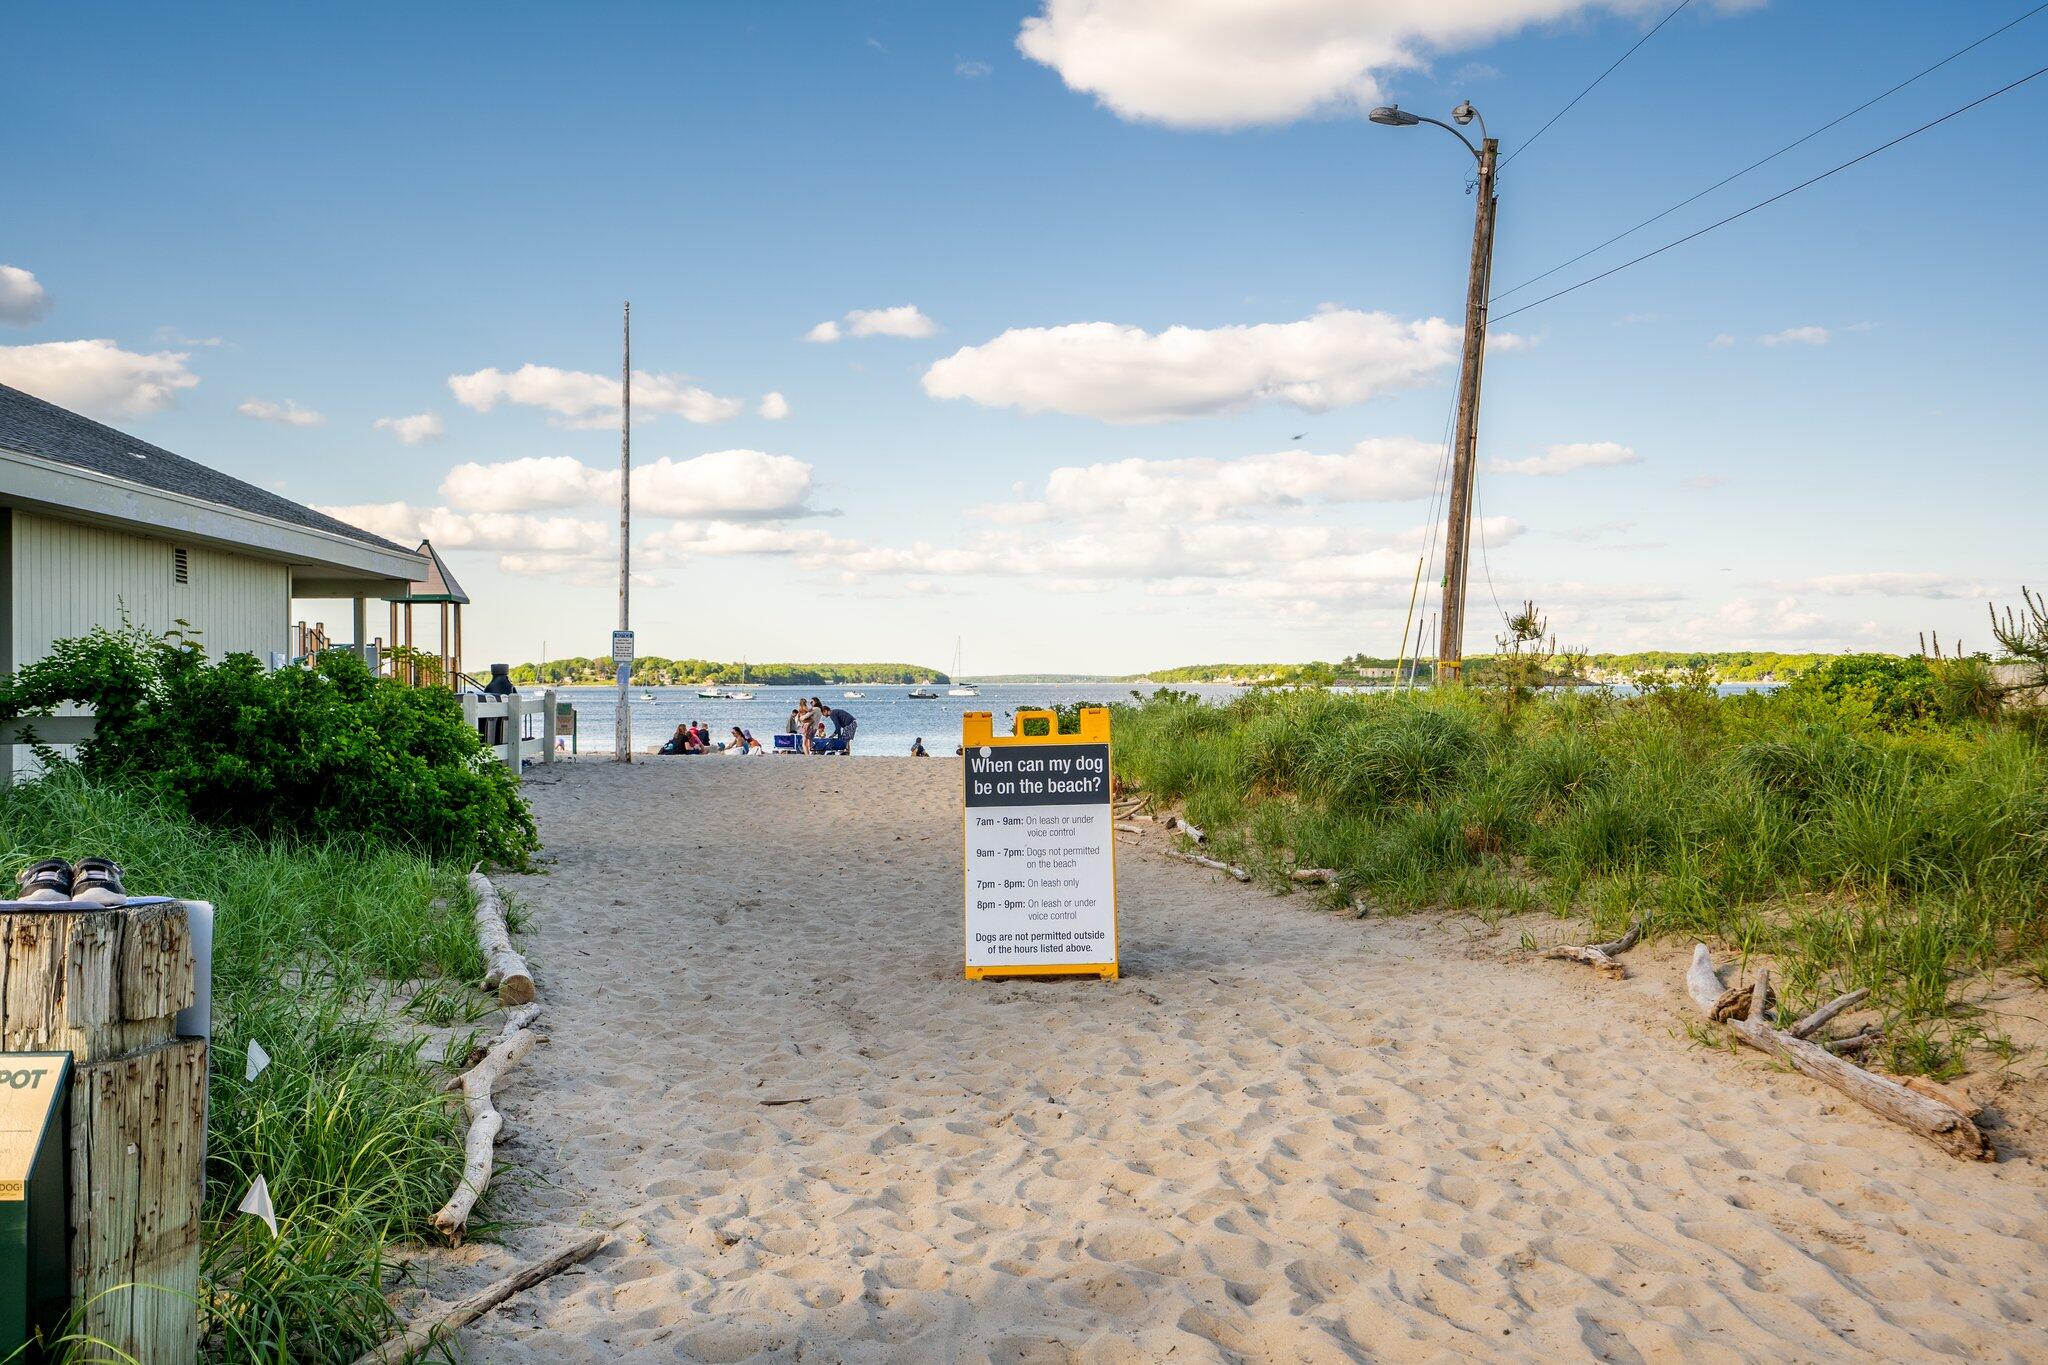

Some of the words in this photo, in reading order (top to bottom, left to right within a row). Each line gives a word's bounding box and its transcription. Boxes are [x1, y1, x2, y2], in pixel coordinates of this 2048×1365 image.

[971, 757, 1013, 773] When
[1018, 759, 1044, 771] can
[1049, 758, 1071, 774] my
[1076, 756, 1103, 773] dog
[974, 780, 992, 794] be
[997, 782, 1014, 794] on
[1019, 779, 1043, 794] the
[1048, 777, 1101, 793] beach?
[976, 818, 994, 826] 7am
[1003, 817, 1023, 825] 9am:
[1026, 816, 1036, 824] On
[1039, 816, 1059, 824] leash
[1072, 816, 1094, 824] under
[1027, 829, 1047, 837] voice
[1049, 828, 1076, 836] control
[976, 849, 994, 857] 9am
[1004, 848, 1024, 858] 7pm:
[1027, 848, 1046, 857] Dogs
[1063, 846, 1100, 857] permitted
[1039, 860, 1051, 868] the
[1053, 860, 1076, 868] beach
[977, 880, 995, 890] 7pm
[1004, 880, 1025, 889] 8pm:
[1028, 879, 1038, 887] On
[1041, 879, 1062, 887] leash
[1064, 879, 1079, 888] only
[977, 901, 995, 910] 8pm
[1004, 900, 1025, 910] 9pm:
[1028, 899, 1039, 907] On
[1042, 899, 1062, 907] leash
[1075, 899, 1096, 907] under
[1028, 912, 1048, 920] voice
[1051, 911, 1076, 920] control
[976, 933, 996, 943] Dogs
[1015, 933, 1028, 941] not
[1031, 931, 1071, 942] permitted
[1074, 931, 1105, 939] outside
[988, 946, 996, 954] of
[999, 945, 1012, 953] the
[1015, 945, 1038, 953] hours
[1040, 944, 1063, 953] listed
[1066, 944, 1093, 952] above.
